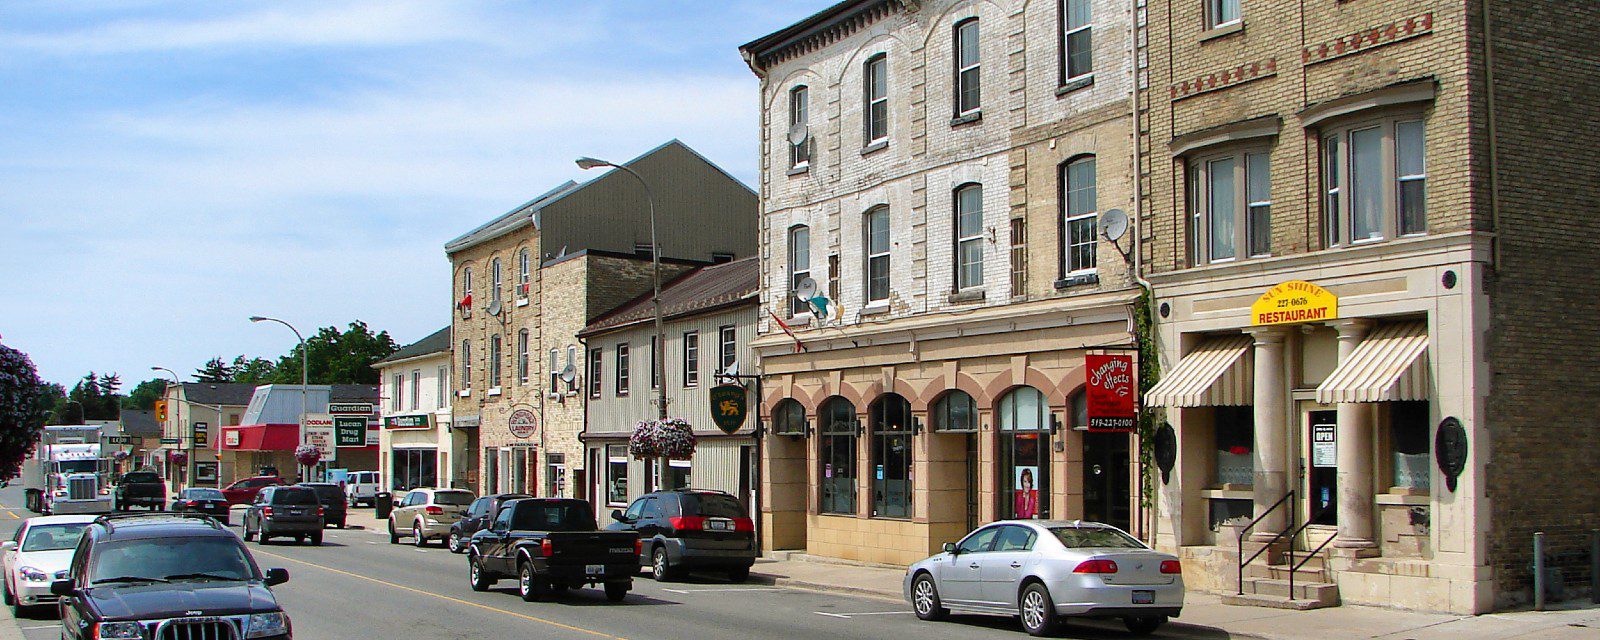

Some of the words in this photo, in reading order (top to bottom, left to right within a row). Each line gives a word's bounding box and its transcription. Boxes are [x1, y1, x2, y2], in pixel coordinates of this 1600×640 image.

[1263, 286, 1282, 302] SUN
[1287, 282, 1324, 298] SHINE
[1277, 297, 1308, 308] 227-0676
[1259, 307, 1328, 324] RESTAURANT
[1090, 357, 1128, 386] Changing
[1103, 372, 1130, 389] effects
[1090, 418, 1133, 429] 519-227-0100
[1315, 432, 1334, 442] OPEN
